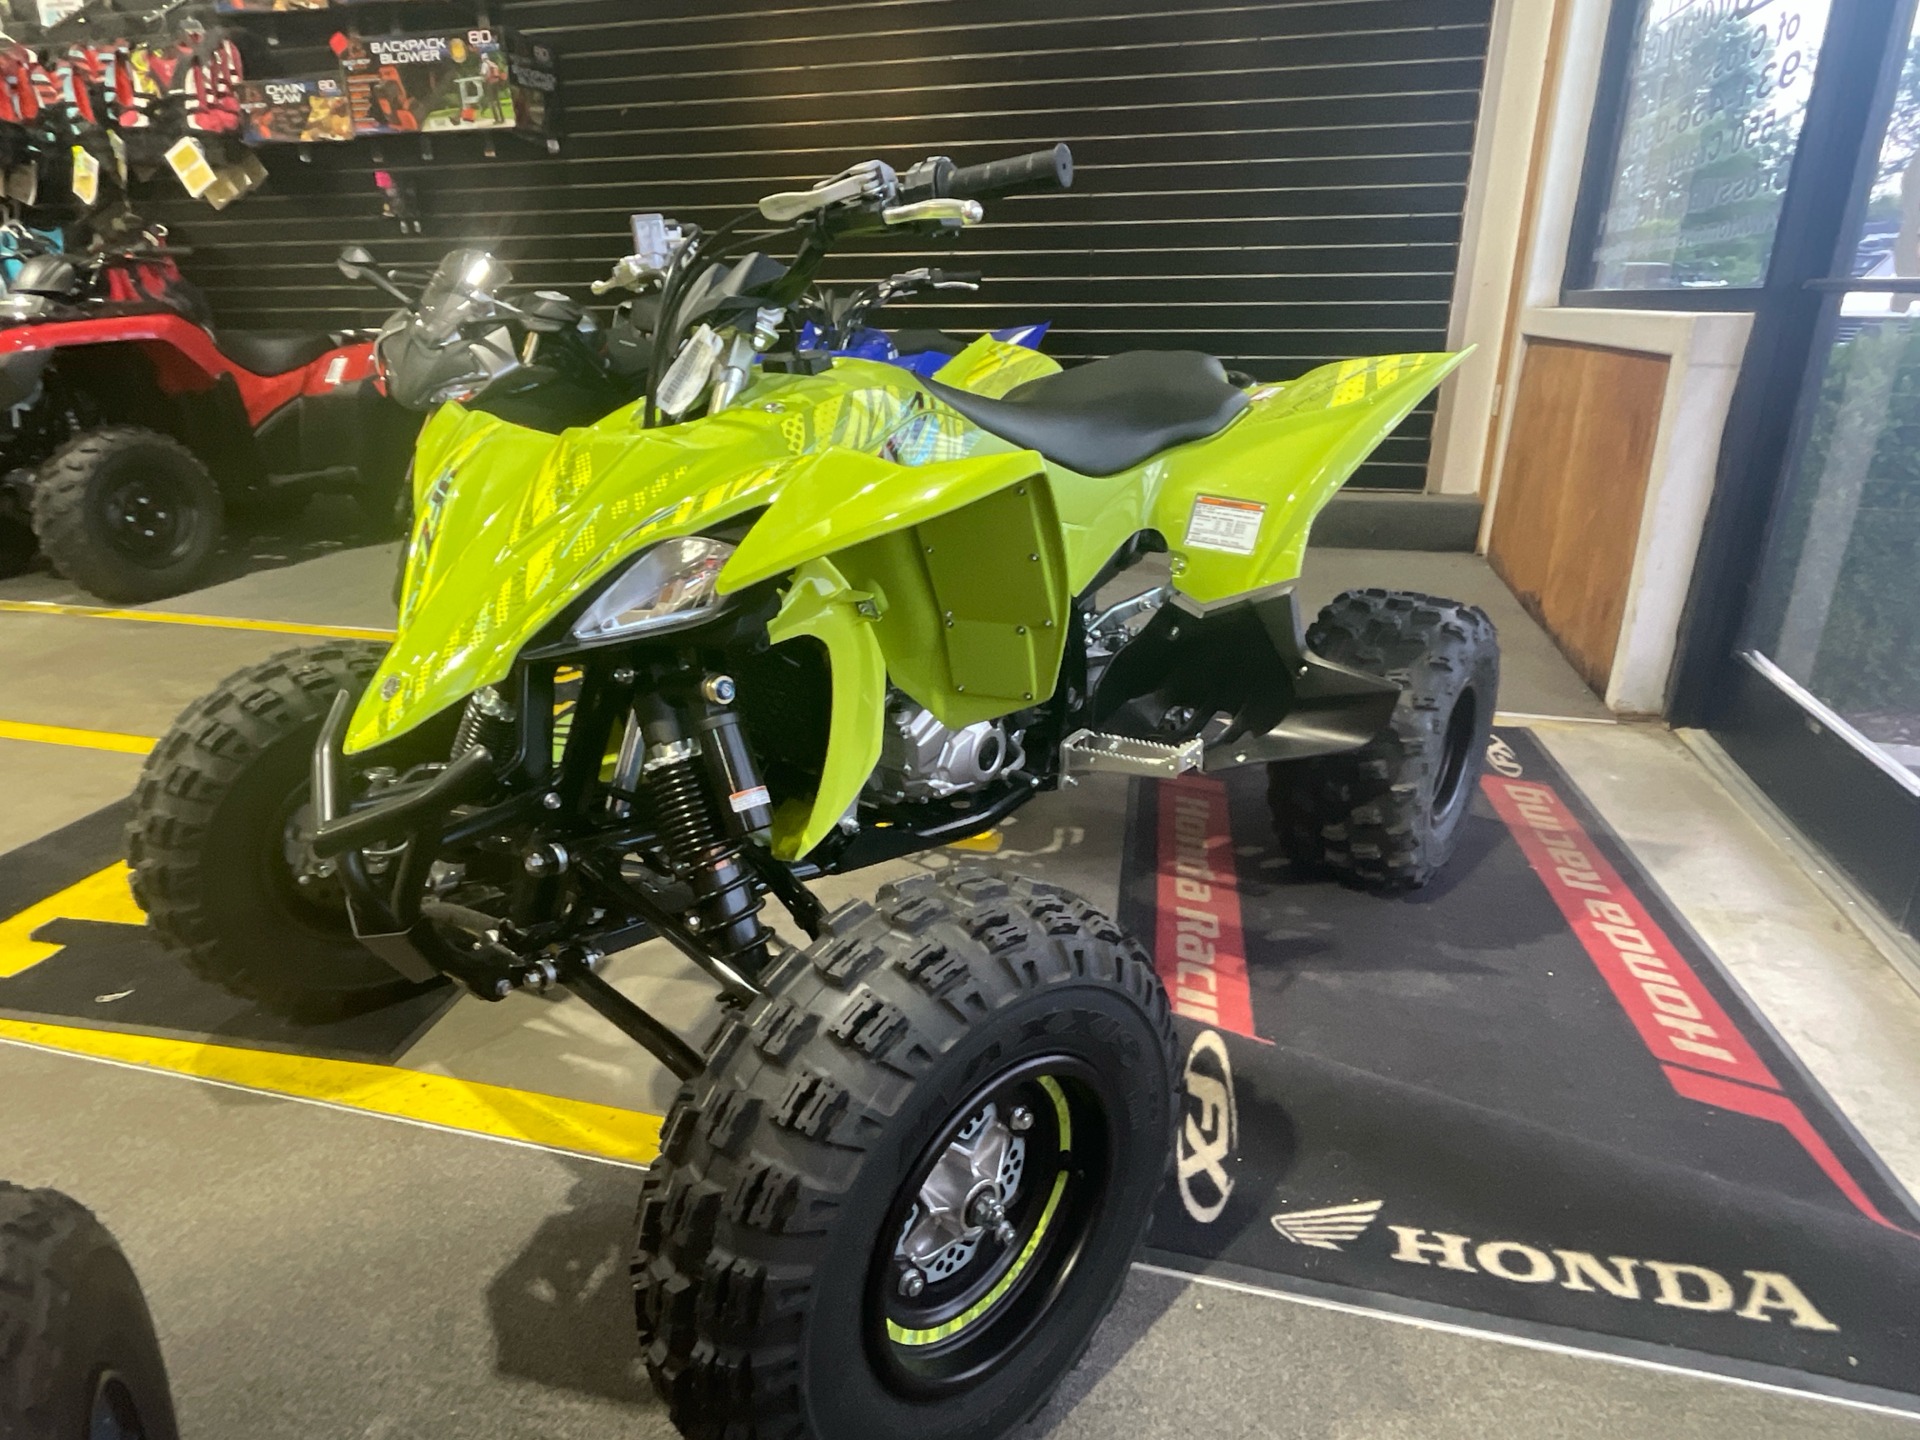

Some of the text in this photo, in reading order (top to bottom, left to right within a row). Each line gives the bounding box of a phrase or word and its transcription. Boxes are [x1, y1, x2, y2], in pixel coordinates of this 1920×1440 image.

[370, 37, 447, 54] BACKPACK
[467, 29, 492, 45] 80
[379, 50, 442, 65] BLOWER
[265, 82, 306, 95] CHAIN
[271, 93, 302, 105] SAW
[1175, 796, 1211, 902] Honda
[1504, 783, 1738, 1065] Honda Racing
[1178, 1068, 1235, 1200] FX
[1388, 1225, 1841, 1332] HONDA
